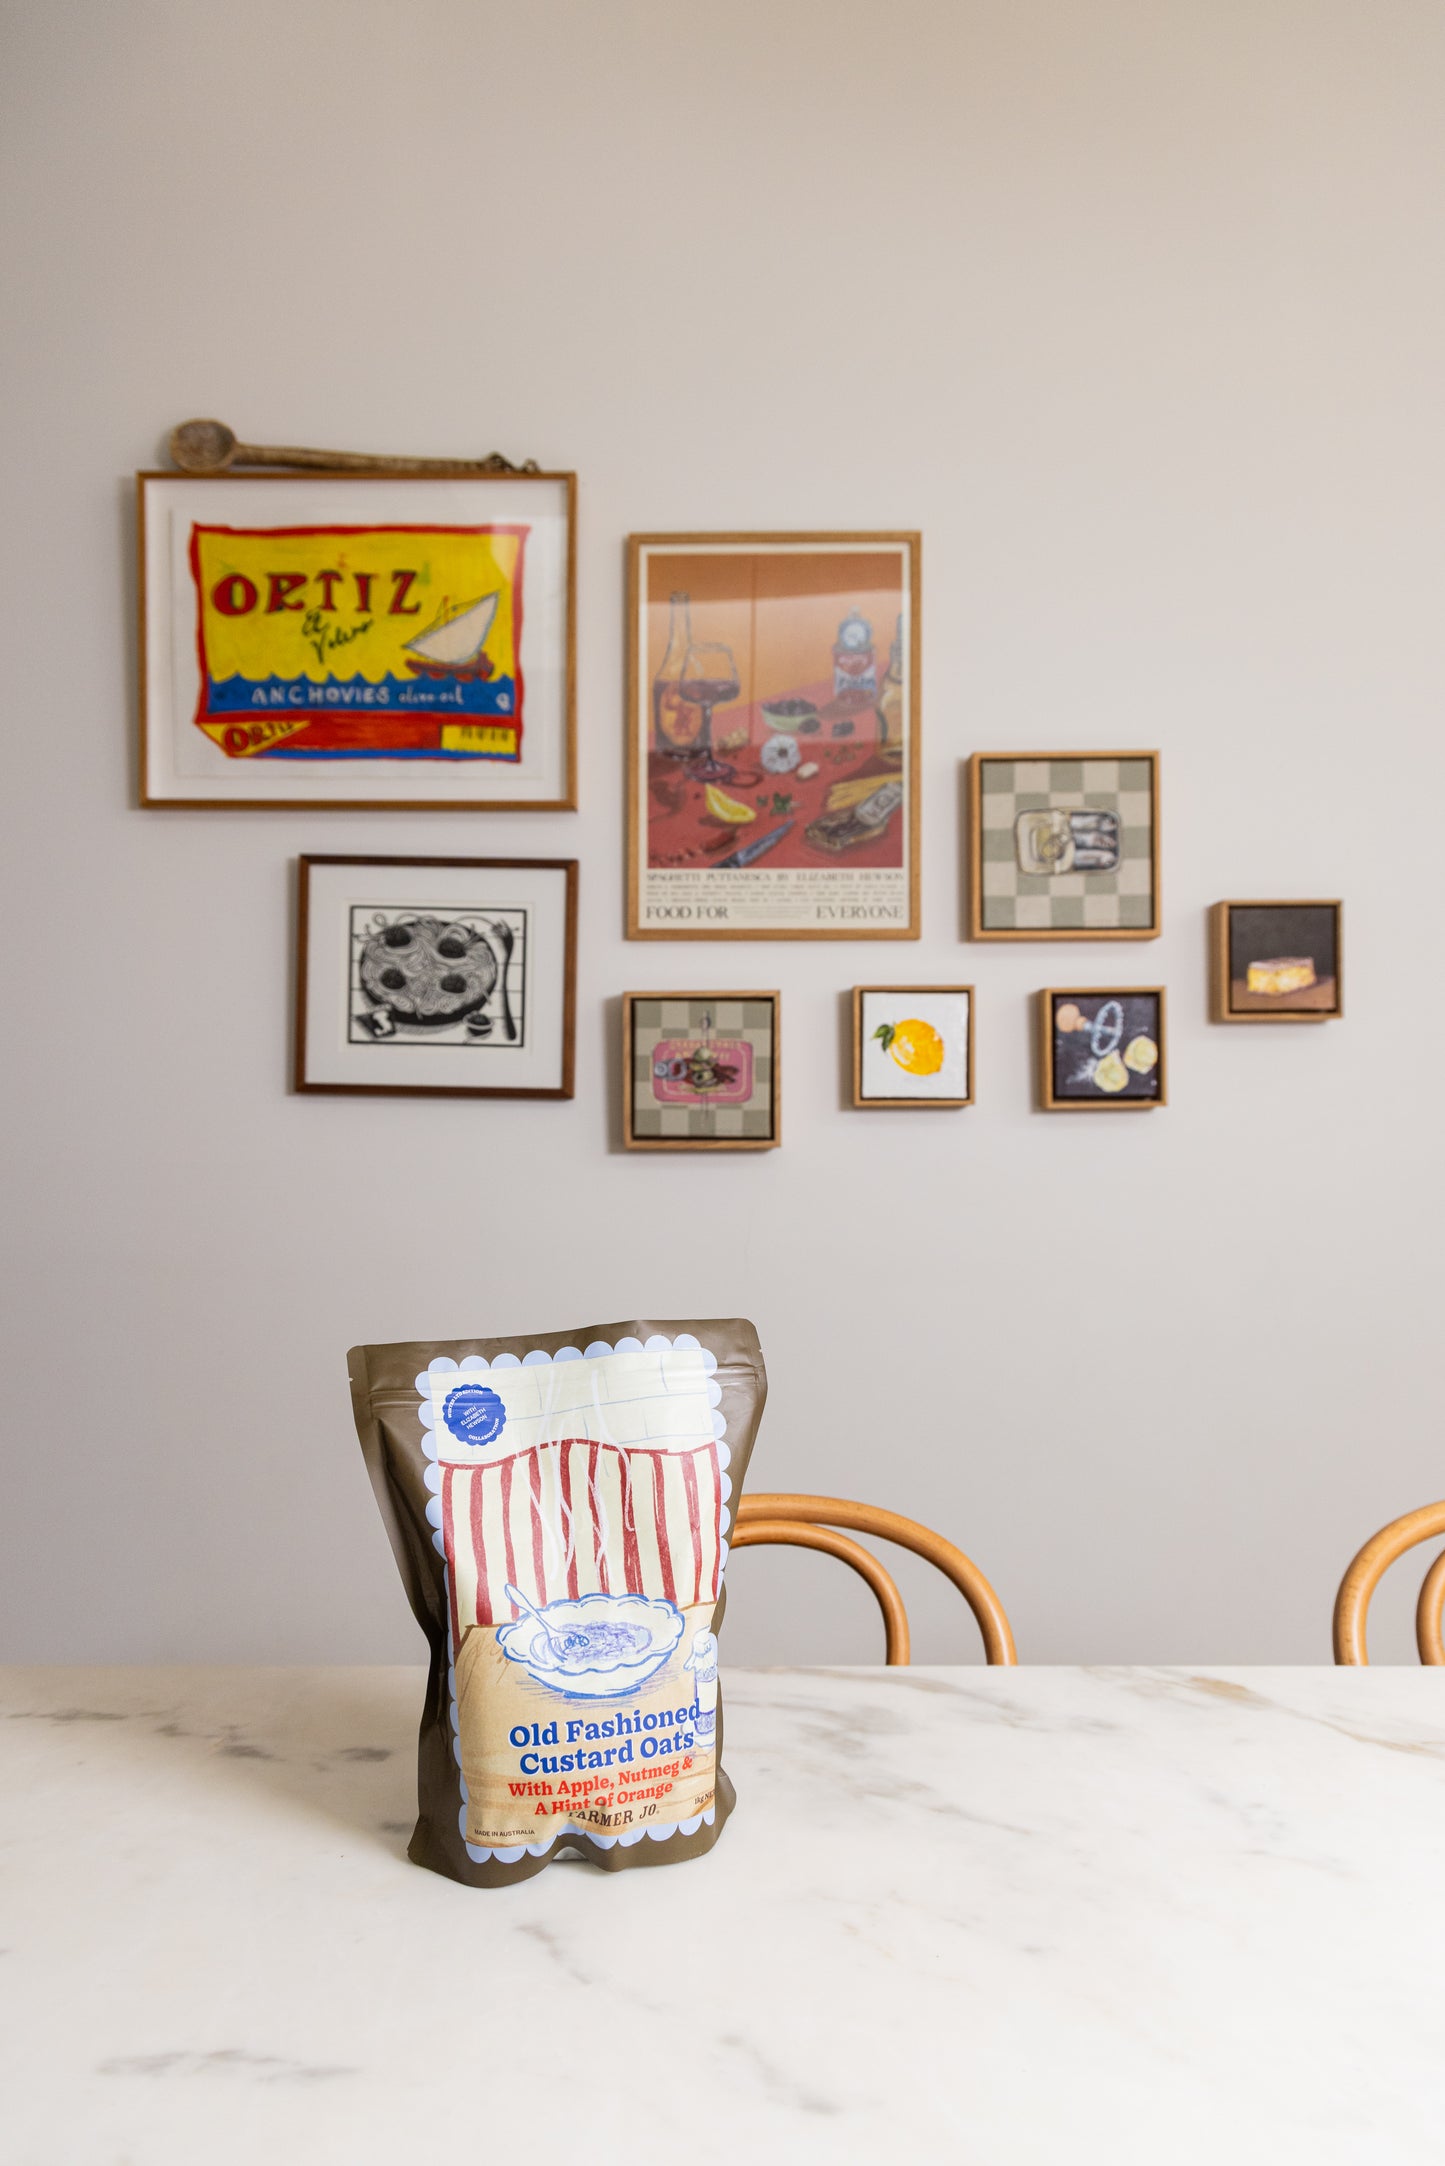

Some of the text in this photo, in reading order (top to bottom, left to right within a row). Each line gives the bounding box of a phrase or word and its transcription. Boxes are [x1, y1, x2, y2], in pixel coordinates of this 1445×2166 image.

[211, 570, 422, 617] ORTIZ
[251, 686, 391, 706] ANCHOVIES
[646, 872, 700, 882] SPAGHETTI
[706, 872, 771, 882] PUTTANESCA
[776, 872, 789, 882] BY
[796, 872, 854, 882] ELIZABETH
[646, 905, 692, 920] FOOD
[697, 905, 729, 920] FOR
[816, 905, 904, 920] EVERYONE
[460, 1407, 487, 1426] ELIZABETH
[463, 1405, 477, 1417] WITH
[466, 1414, 487, 1430] HEWSON
[468, 1417, 500, 1441] COLLABORATION
[509, 1699, 701, 1748] Old Fashioned
[519, 1731, 695, 1775] Custard Oats
[508, 1756, 693, 1798] With Apple, Nutmeg &
[534, 1782, 673, 1816] A Hint Of Orange
[474, 1828, 491, 1837] MADE
[499, 1829, 536, 1837] AUSTRALIA
